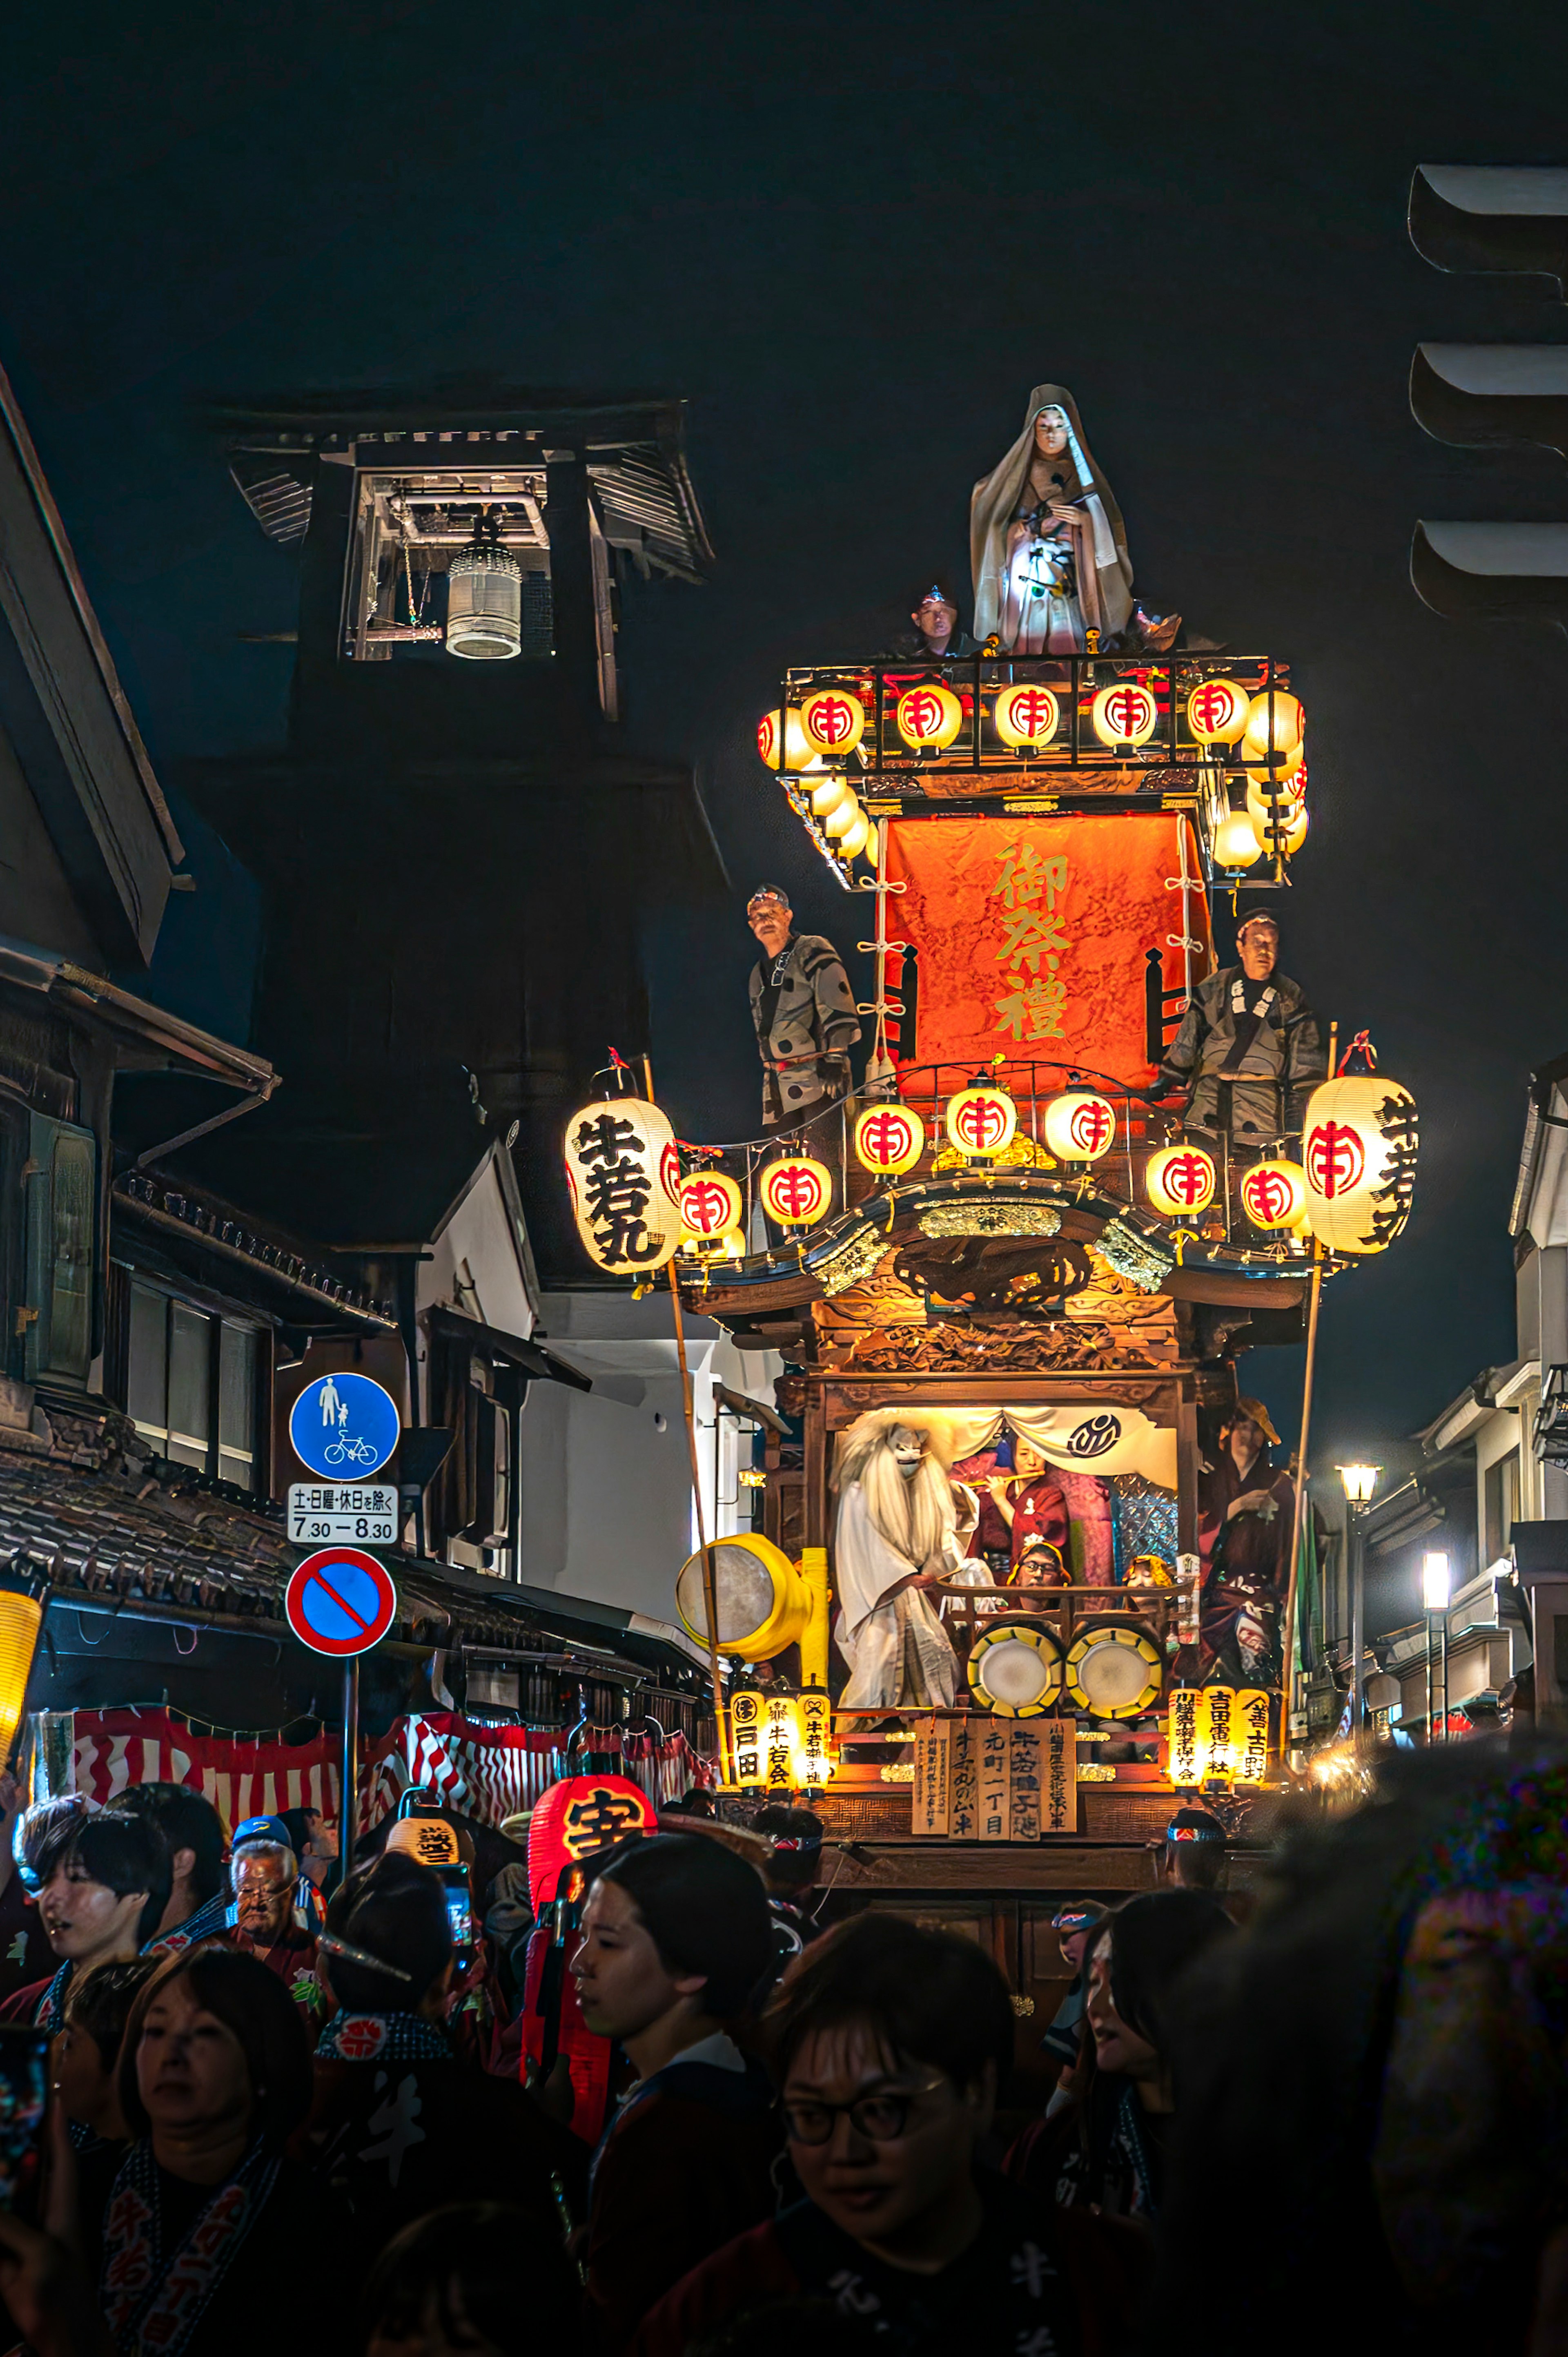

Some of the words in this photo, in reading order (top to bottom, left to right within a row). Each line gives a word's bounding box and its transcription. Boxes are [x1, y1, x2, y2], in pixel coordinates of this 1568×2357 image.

[990, 842, 1072, 1041] 御祭禮
[572, 1114, 665, 1266] 牛若丸
[294, 1489, 392, 1512] 土・日曜・休日を除く
[736, 1726, 758, 1779] 戸田
[768, 1726, 789, 1784] 牛若会
[984, 1732, 1005, 1836] 元町一丁目
